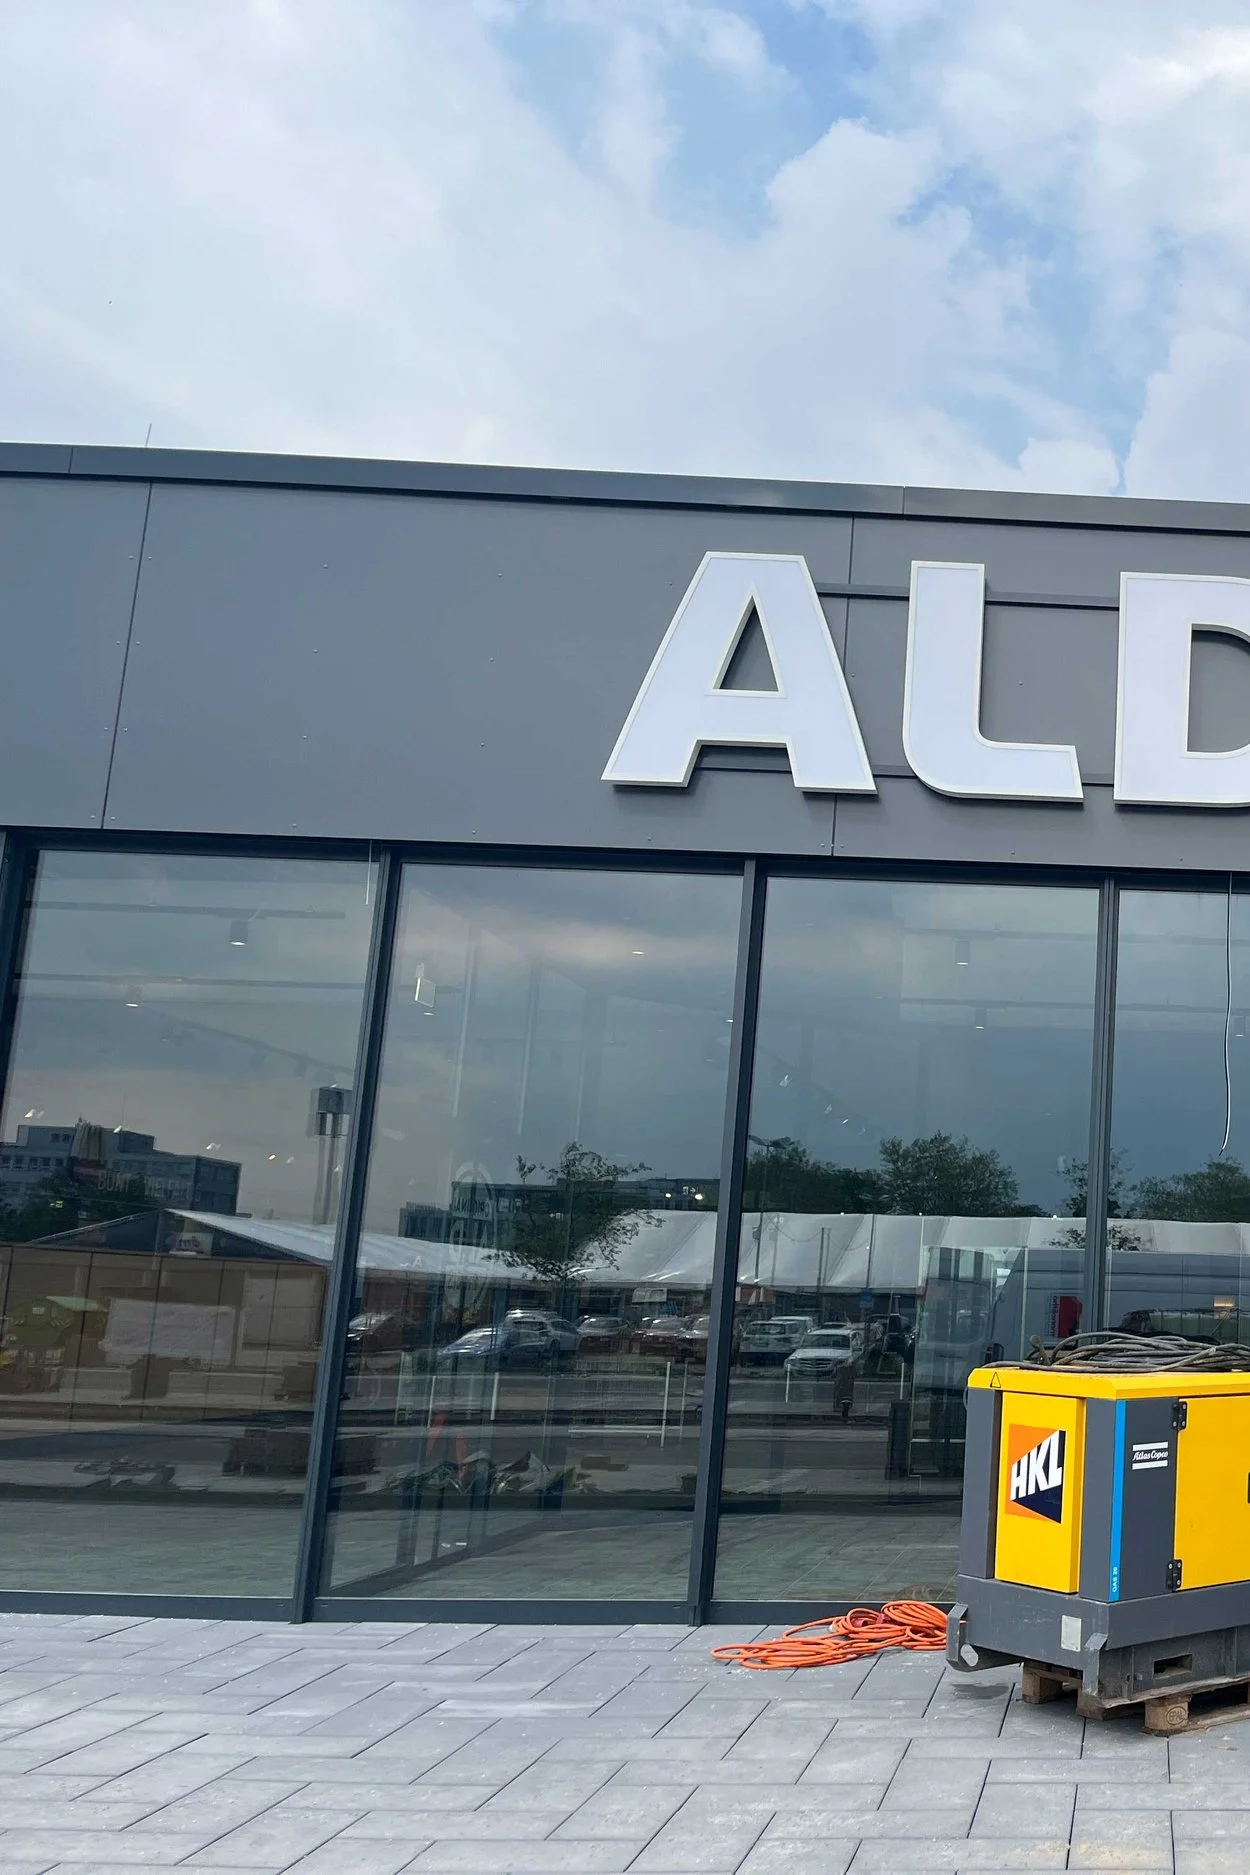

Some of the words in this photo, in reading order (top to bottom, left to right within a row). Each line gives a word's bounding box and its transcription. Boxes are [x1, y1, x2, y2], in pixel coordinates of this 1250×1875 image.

[1010, 1430, 1063, 1500] HKL
[1132, 1451, 1150, 1461] Atlas
[1151, 1450, 1168, 1460] Copco
